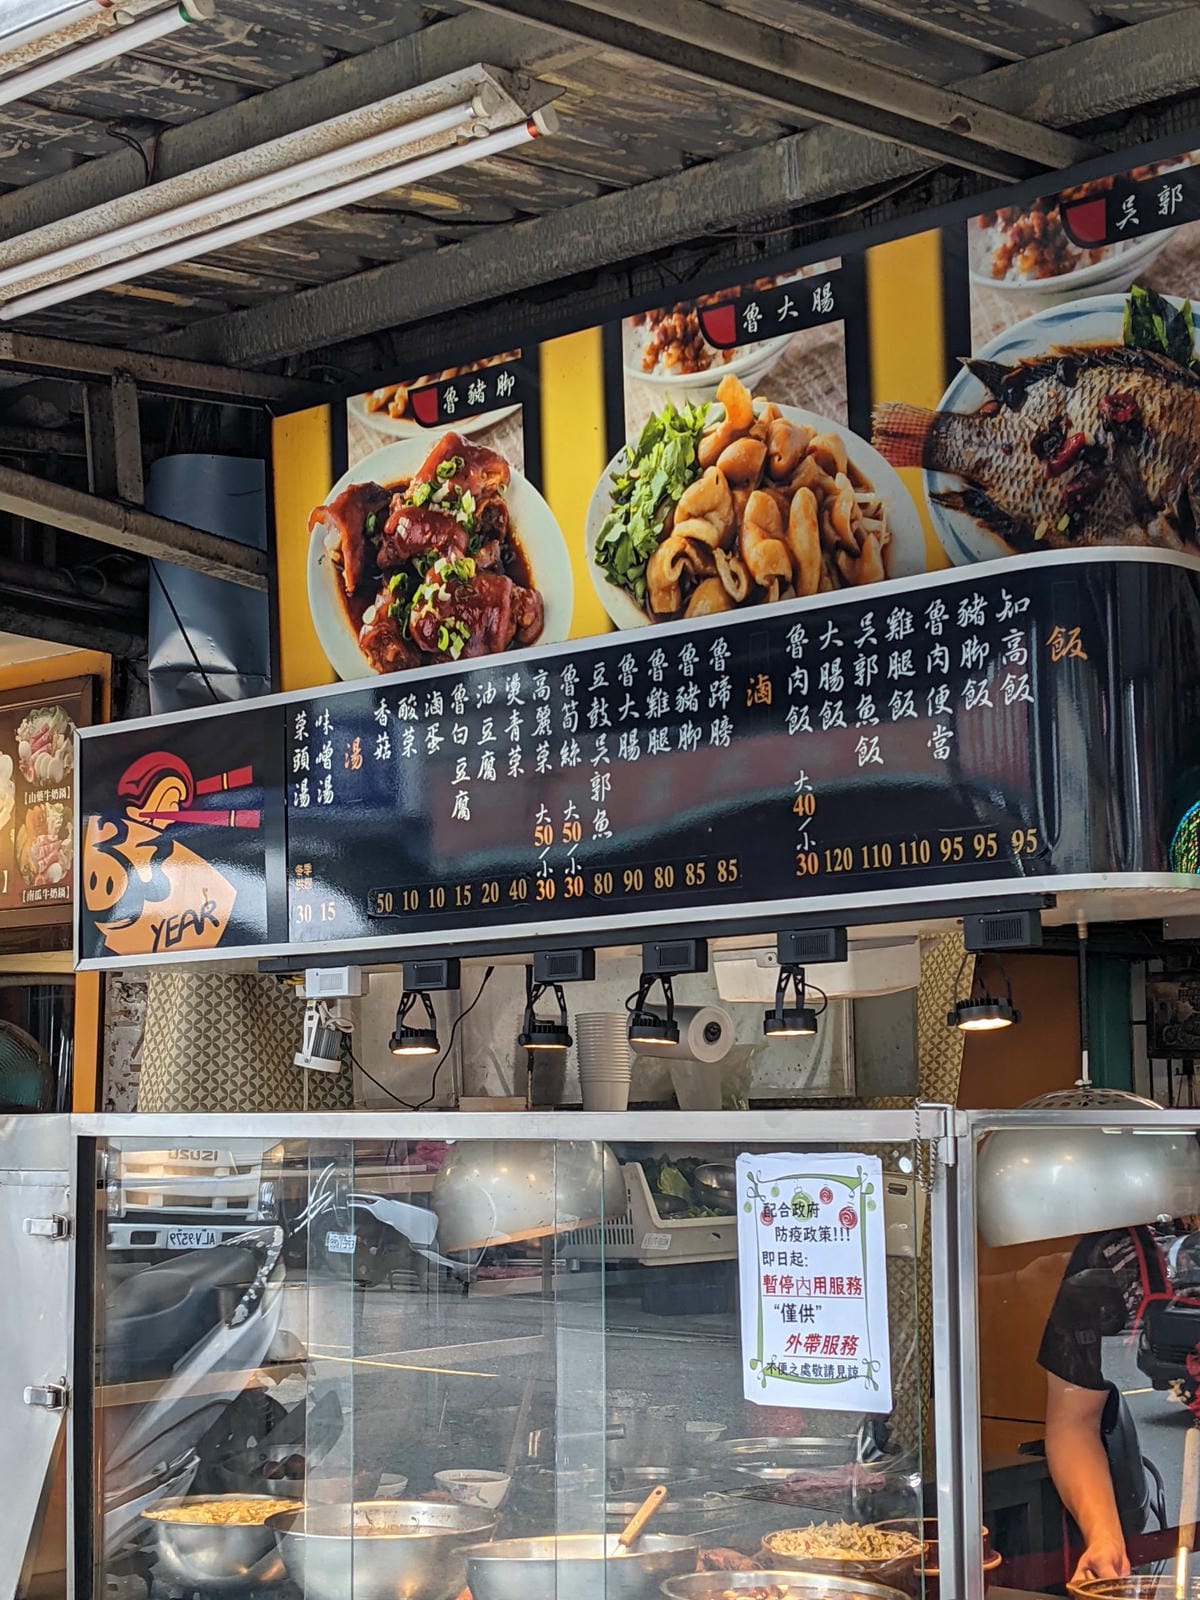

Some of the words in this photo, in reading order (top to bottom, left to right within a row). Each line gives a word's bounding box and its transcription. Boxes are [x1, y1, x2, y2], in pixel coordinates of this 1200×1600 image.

[742, 282, 835, 334] 魯大腸
[708, 637, 735, 747] 魯蹄膀
[746, 673, 773, 707] 滷
[785, 624, 814, 736] 魯肉飯
[818, 620, 847, 731] 大腸飯
[853, 612, 884, 768] 吳郭魚飯
[885, 606, 918, 721] 雞腿飯
[924, 598, 955, 760] 魯肉便當
[995, 588, 1035, 707] 知高飯
[1046, 625, 1088, 662] 飯
[373, 698, 392, 761] 香菇
[398, 693, 419, 758] 酸菜
[424, 690, 445, 755] 滷蛋
[476, 682, 496, 782] 油豆腐
[504, 672, 526, 778] 燙青菜
[531, 669, 552, 774] 高麗菜
[560, 664, 581, 767] 魯筍絲
[617, 653, 641, 761] 魯大腸
[646, 648, 673, 754] 魯雞腿
[292, 710, 311, 808] 菜頭湯
[315, 708, 335, 805] 味噌湯
[344, 737, 364, 770] 湯
[451, 683, 473, 821] 魯白豆腐
[377, 893, 393, 913] 50
[403, 890, 419, 910] 10
[429, 888, 445, 908] 10
[455, 885, 472, 905] 15
[482, 882, 499, 903] 20
[509, 878, 527, 900] 40
[594, 872, 614, 895] 80
[623, 869, 643, 892] 90
[654, 866, 675, 889] 80
[685, 862, 706, 885] 85
[717, 859, 738, 883] 85
[825, 847, 853, 873] 120
[861, 843, 892, 869] 110
[899, 839, 931, 866] 110
[939, 836, 964, 862] 95
[973, 833, 998, 858] 95
[1011, 828, 1038, 855] 95
[151, 900, 220, 953] YEAR
[296, 905, 312, 924] 30
[320, 902, 336, 921] 15
[762, 1201, 820, 1219] 配合政府
[774, 1226, 851, 1243] 防疫政策!!!
[766, 1361, 860, 1380] 不便之處敬請見諒
[785, 1333, 859, 1356] 外帶服務
